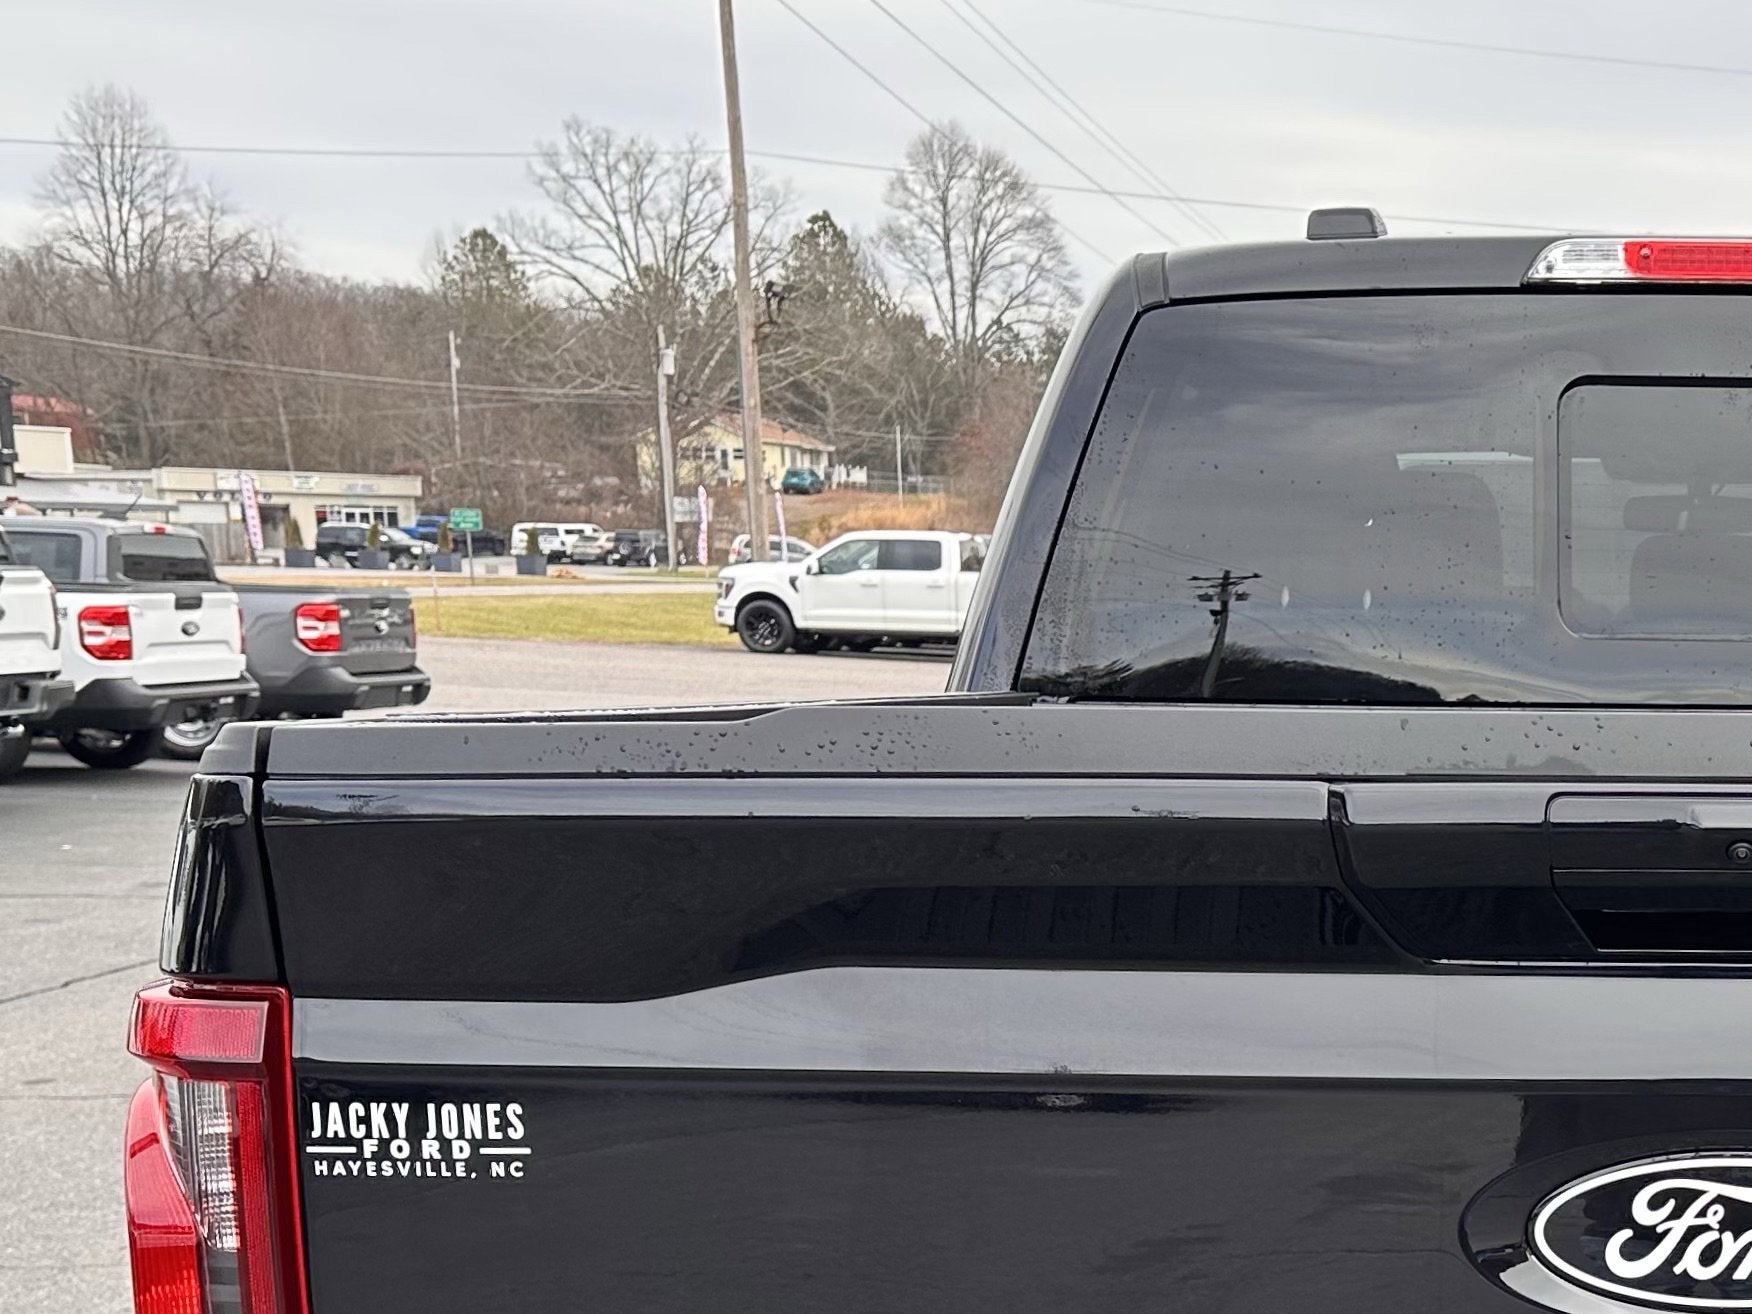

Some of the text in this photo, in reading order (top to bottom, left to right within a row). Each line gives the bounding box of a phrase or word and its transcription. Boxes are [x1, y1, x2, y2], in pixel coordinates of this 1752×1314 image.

[311, 1102, 525, 1140] JACKY JONES
[362, 1138, 472, 1160] FORD
[314, 1160, 524, 1179] HAYESVILLE, NC
